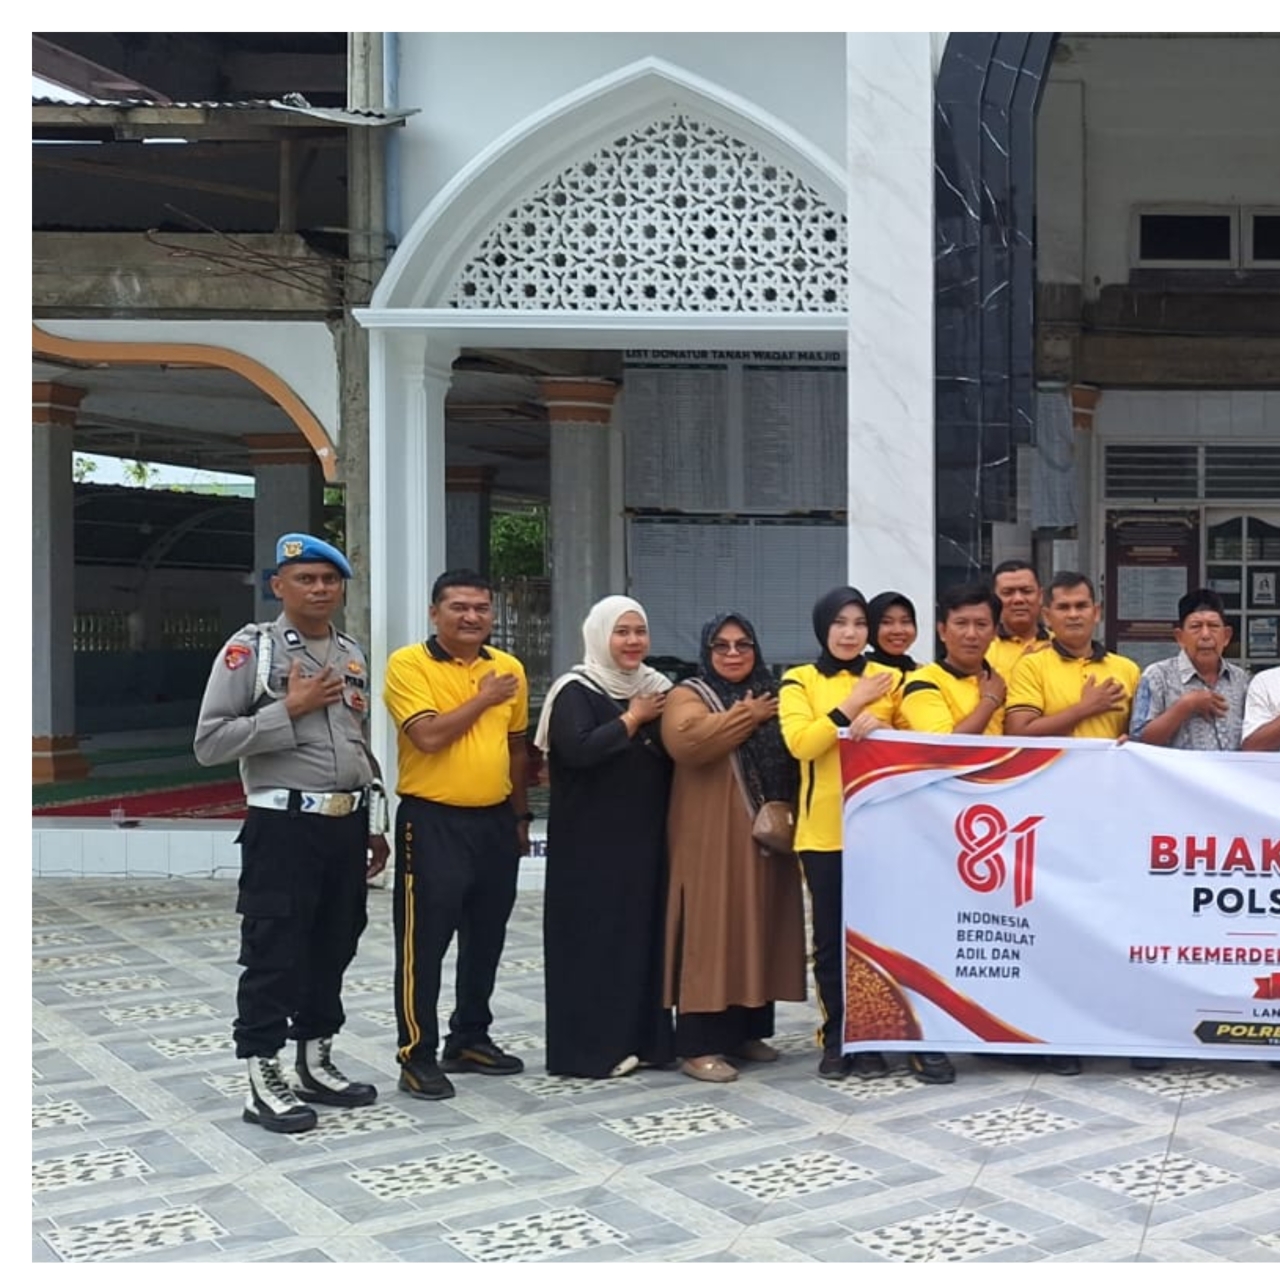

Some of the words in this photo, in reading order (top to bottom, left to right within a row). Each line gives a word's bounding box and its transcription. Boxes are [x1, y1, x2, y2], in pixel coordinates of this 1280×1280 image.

[955, 804, 1047, 908] 81
[957, 911, 1030, 929] INDONESIA
[957, 930, 1036, 946] BERDAULAT
[956, 948, 987, 960] ADIL
[992, 948, 1020, 960] DAN
[1129, 946, 1171, 963] HUT
[956, 966, 1020, 978] MAKMUR
